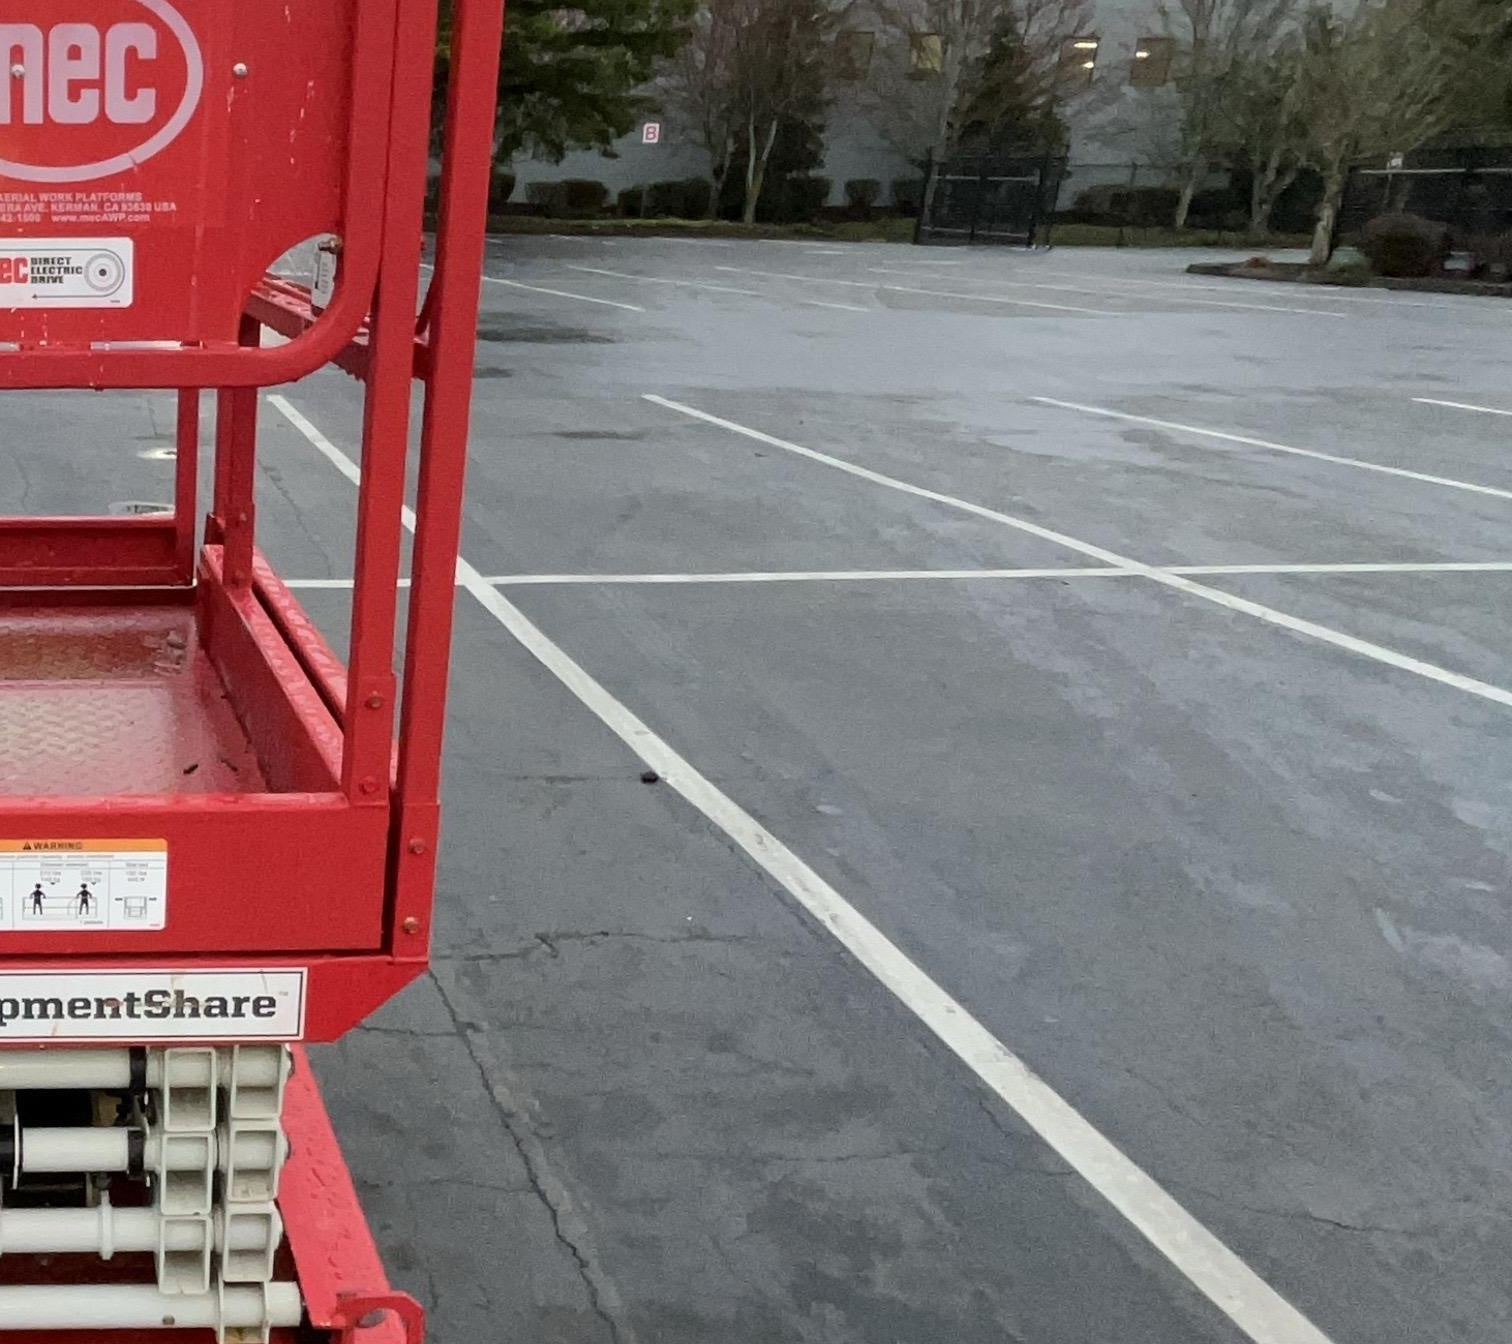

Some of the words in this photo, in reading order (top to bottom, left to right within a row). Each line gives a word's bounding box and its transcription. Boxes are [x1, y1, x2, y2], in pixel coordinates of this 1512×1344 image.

[39, 192, 73, 203] WORK
[75, 192, 143, 202] PLATFORMS
[103, 202, 119, 212] CA
[154, 202, 177, 212] USA
[30, 256, 72, 265] DIRECT
[30, 266, 83, 275] ELECTRIC
[30, 275, 65, 284] DRIVE
[33, 841, 83, 850] WARNING
